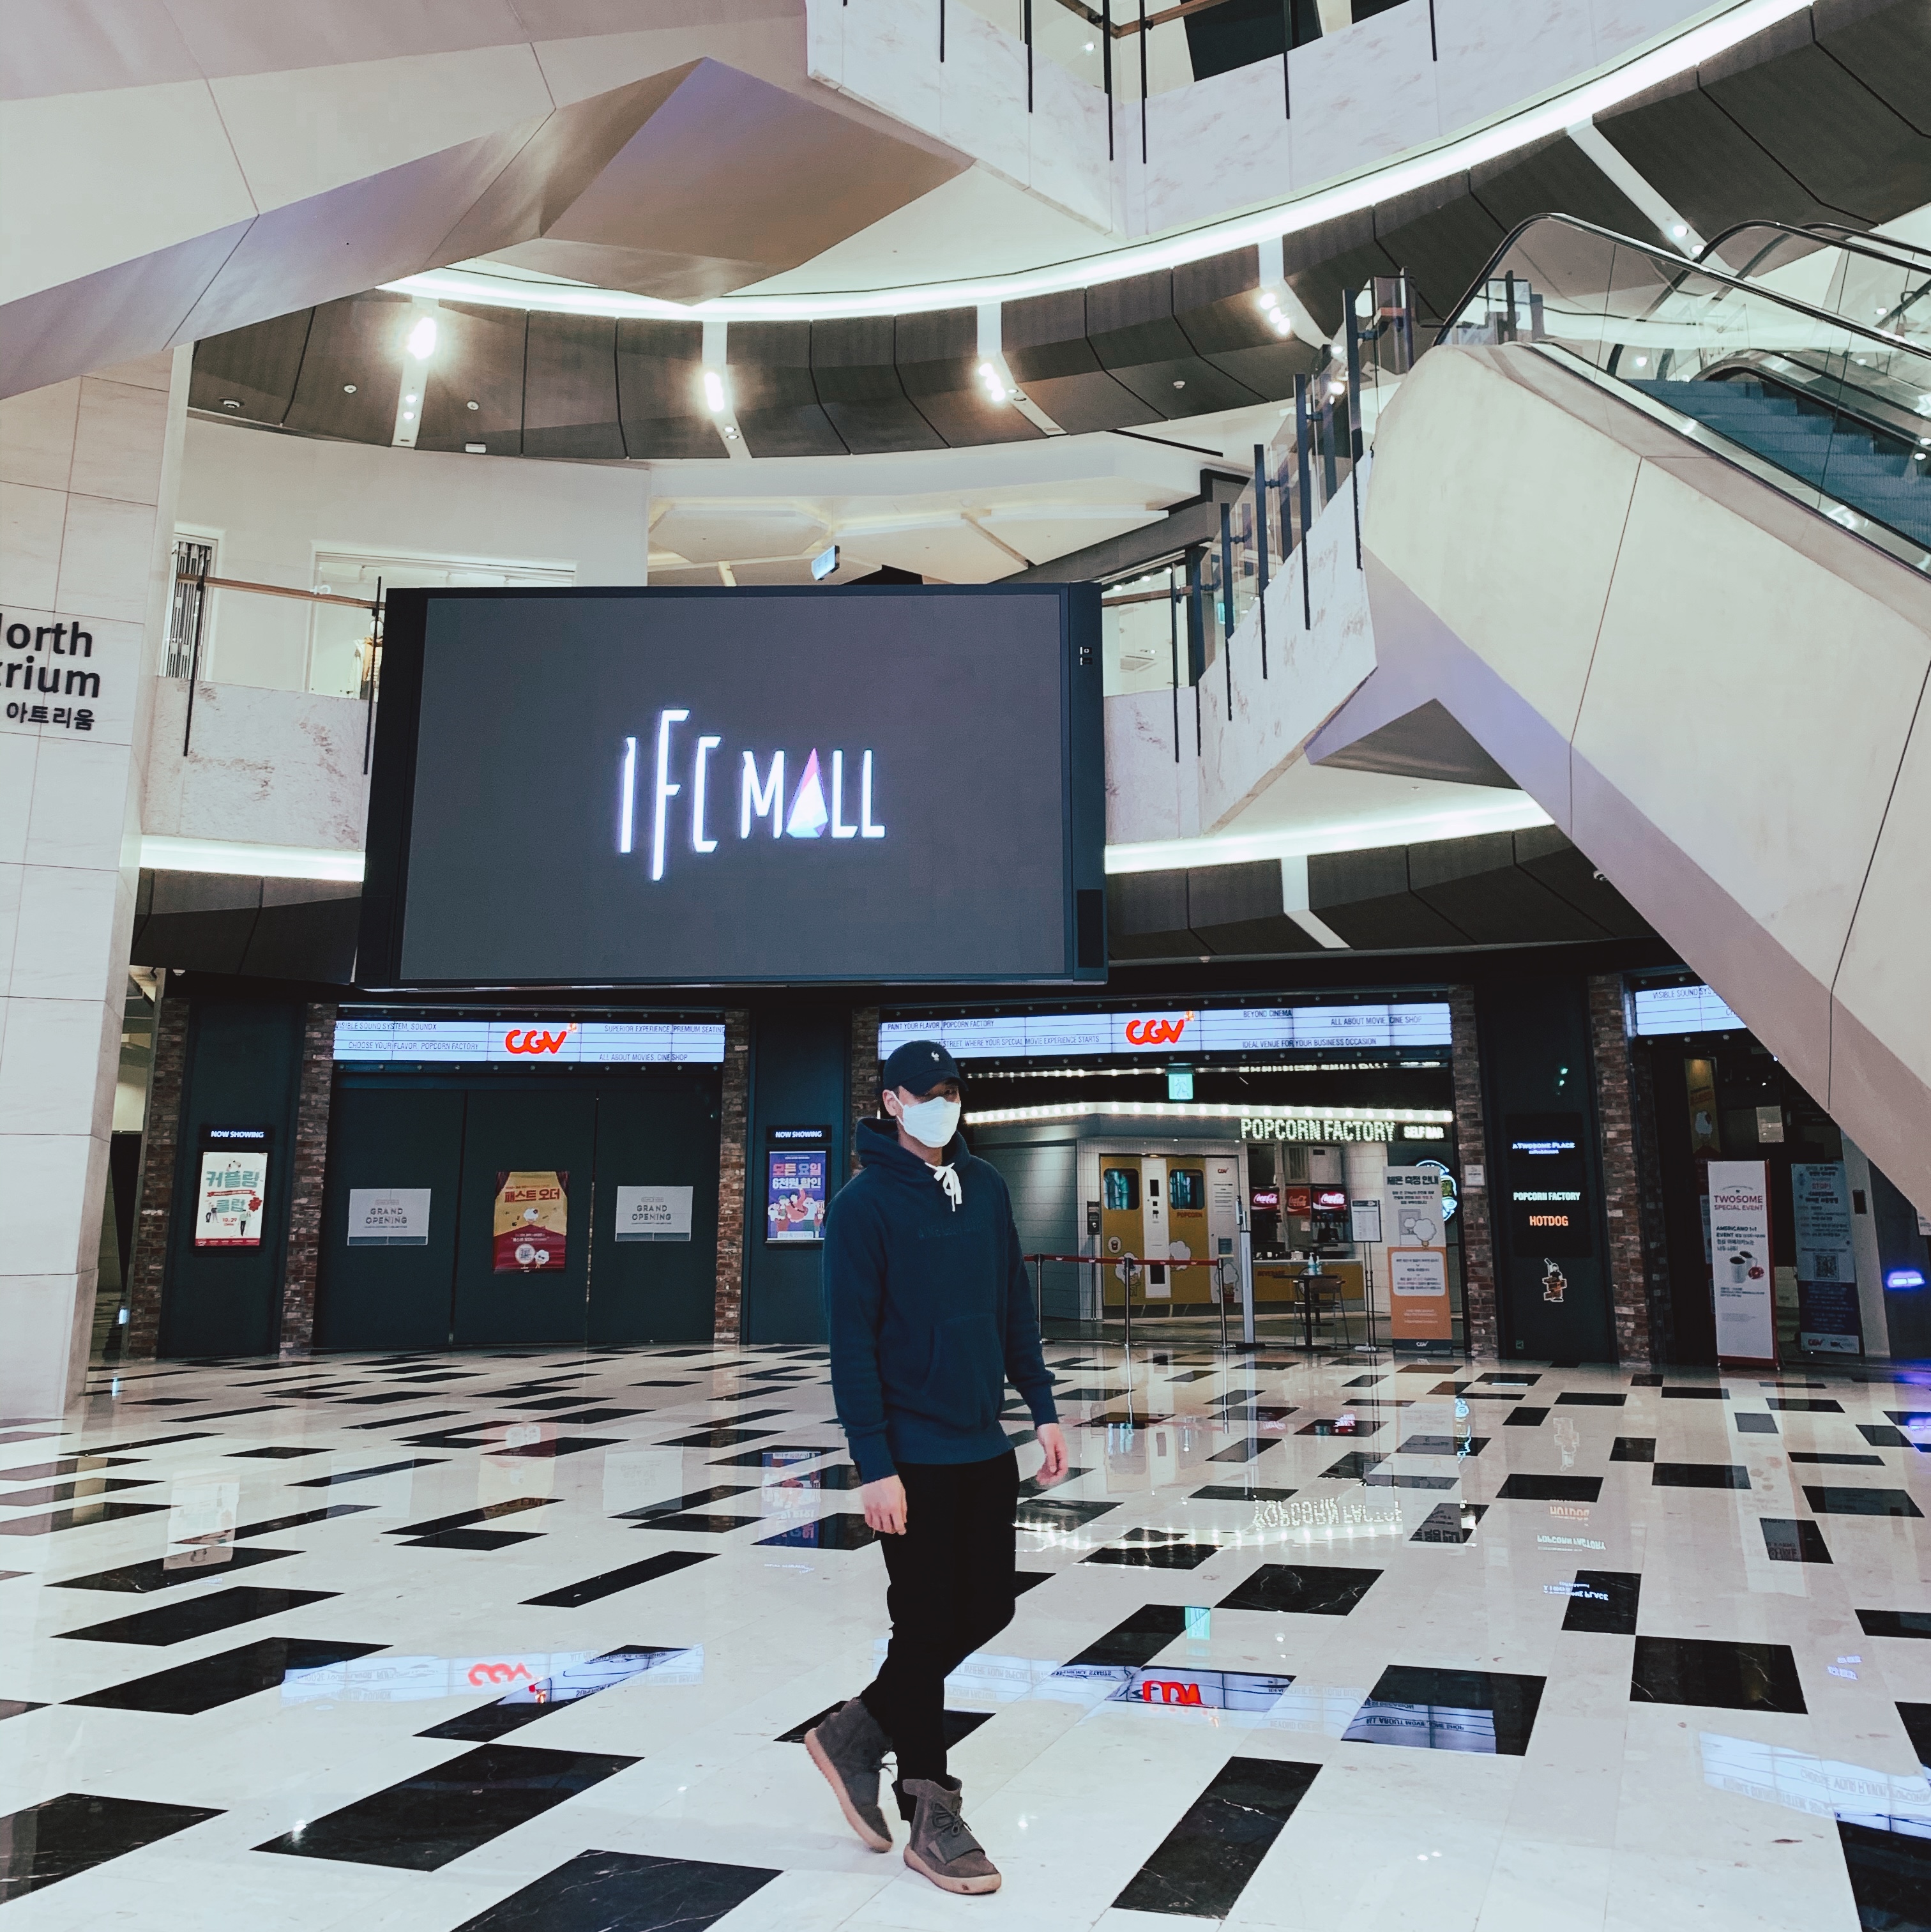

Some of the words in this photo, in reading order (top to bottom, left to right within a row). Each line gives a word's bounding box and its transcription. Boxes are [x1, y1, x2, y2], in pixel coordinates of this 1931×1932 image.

[0, 613, 92, 657] orth
[0, 655, 100, 697] rium
[6, 702, 95, 731] 아트리움
[621, 710, 722, 881] IFC
[741, 749, 886, 839] MALL
[1653, 990, 1674, 999] VISIBLE
[1676, 989, 1699, 998] SOUND
[1126, 1019, 1185, 1045] CGV
[505, 1030, 567, 1054] CGV
[1044, 1036, 1077, 1044] EXPERIENCE
[1314, 1038, 1344, 1046] BUSINESS
[1345, 1037, 1376, 1046] OCCASION
[1241, 1118, 1321, 1140] POPCORN
[1323, 1120, 1396, 1141] FACTORY
[1404, 1125, 1425, 1138] SELF
[1425, 1126, 1444, 1139] BAR
[773, 1163, 796, 1176] 모든
[798, 1162, 821, 1176] 요일
[1405, 1176, 1421, 1185] 측정
[1422, 1175, 1439, 1185] 안내
[504, 1190, 536, 1203] 패스트
[538, 1189, 560, 1201] 오더
[1513, 1192, 1547, 1201] POPCORN
[1548, 1192, 1580, 1201] FACTORY
[1714, 1195, 1763, 1203] TWOSOME
[1529, 1215, 1569, 1226] HOTDOG
